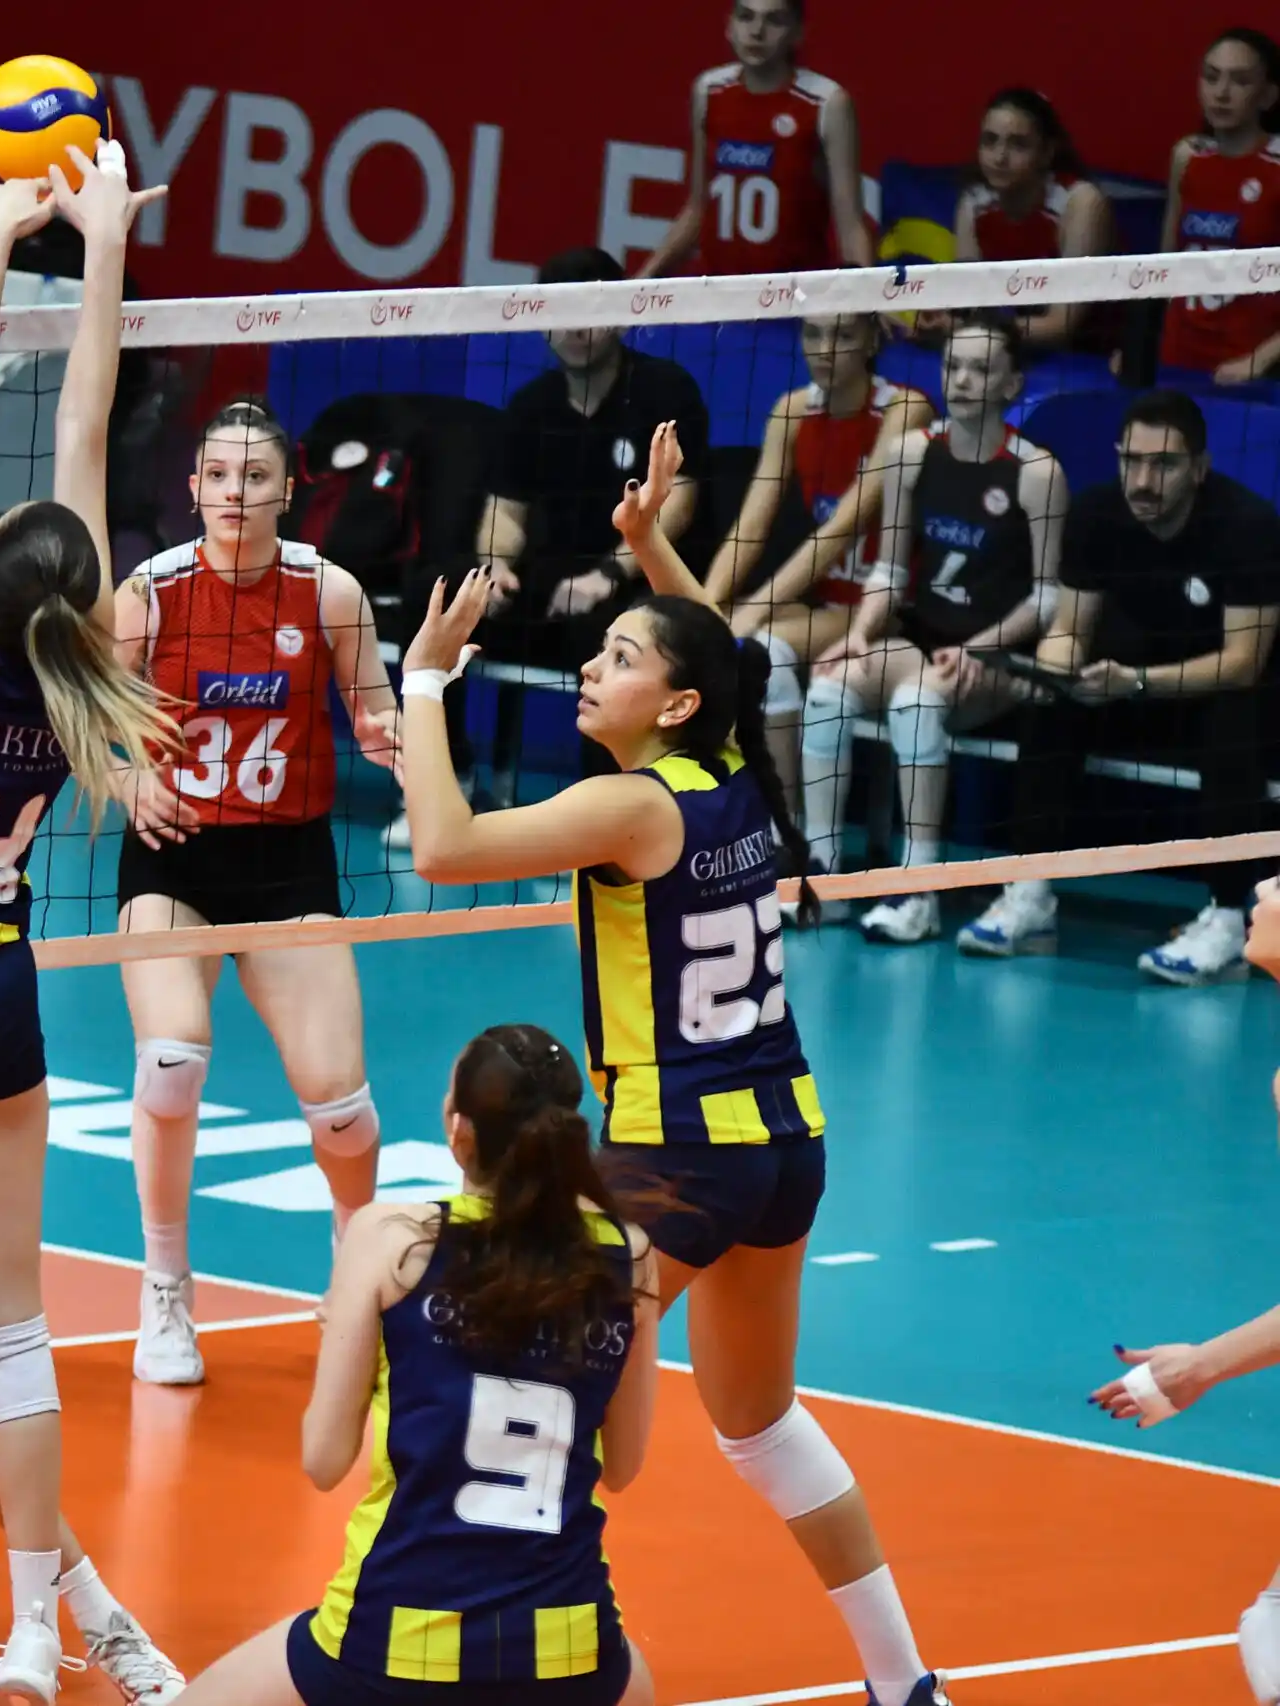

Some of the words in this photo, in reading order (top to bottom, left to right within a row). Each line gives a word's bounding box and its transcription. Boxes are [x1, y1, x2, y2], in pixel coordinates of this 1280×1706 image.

[709, 174, 780, 244] 10
[1023, 275, 1050, 292] TVF
[1145, 268, 1171, 285] TVF
[901, 279, 926, 296] TVF
[520, 299, 546, 316] TVF
[650, 293, 676, 310] TVF
[257, 309, 283, 327] TVF
[389, 303, 417, 321] TVF
[204, 675, 284, 706] Orkid
[173, 715, 290, 804] 36
[454, 1373, 576, 1534] 9
